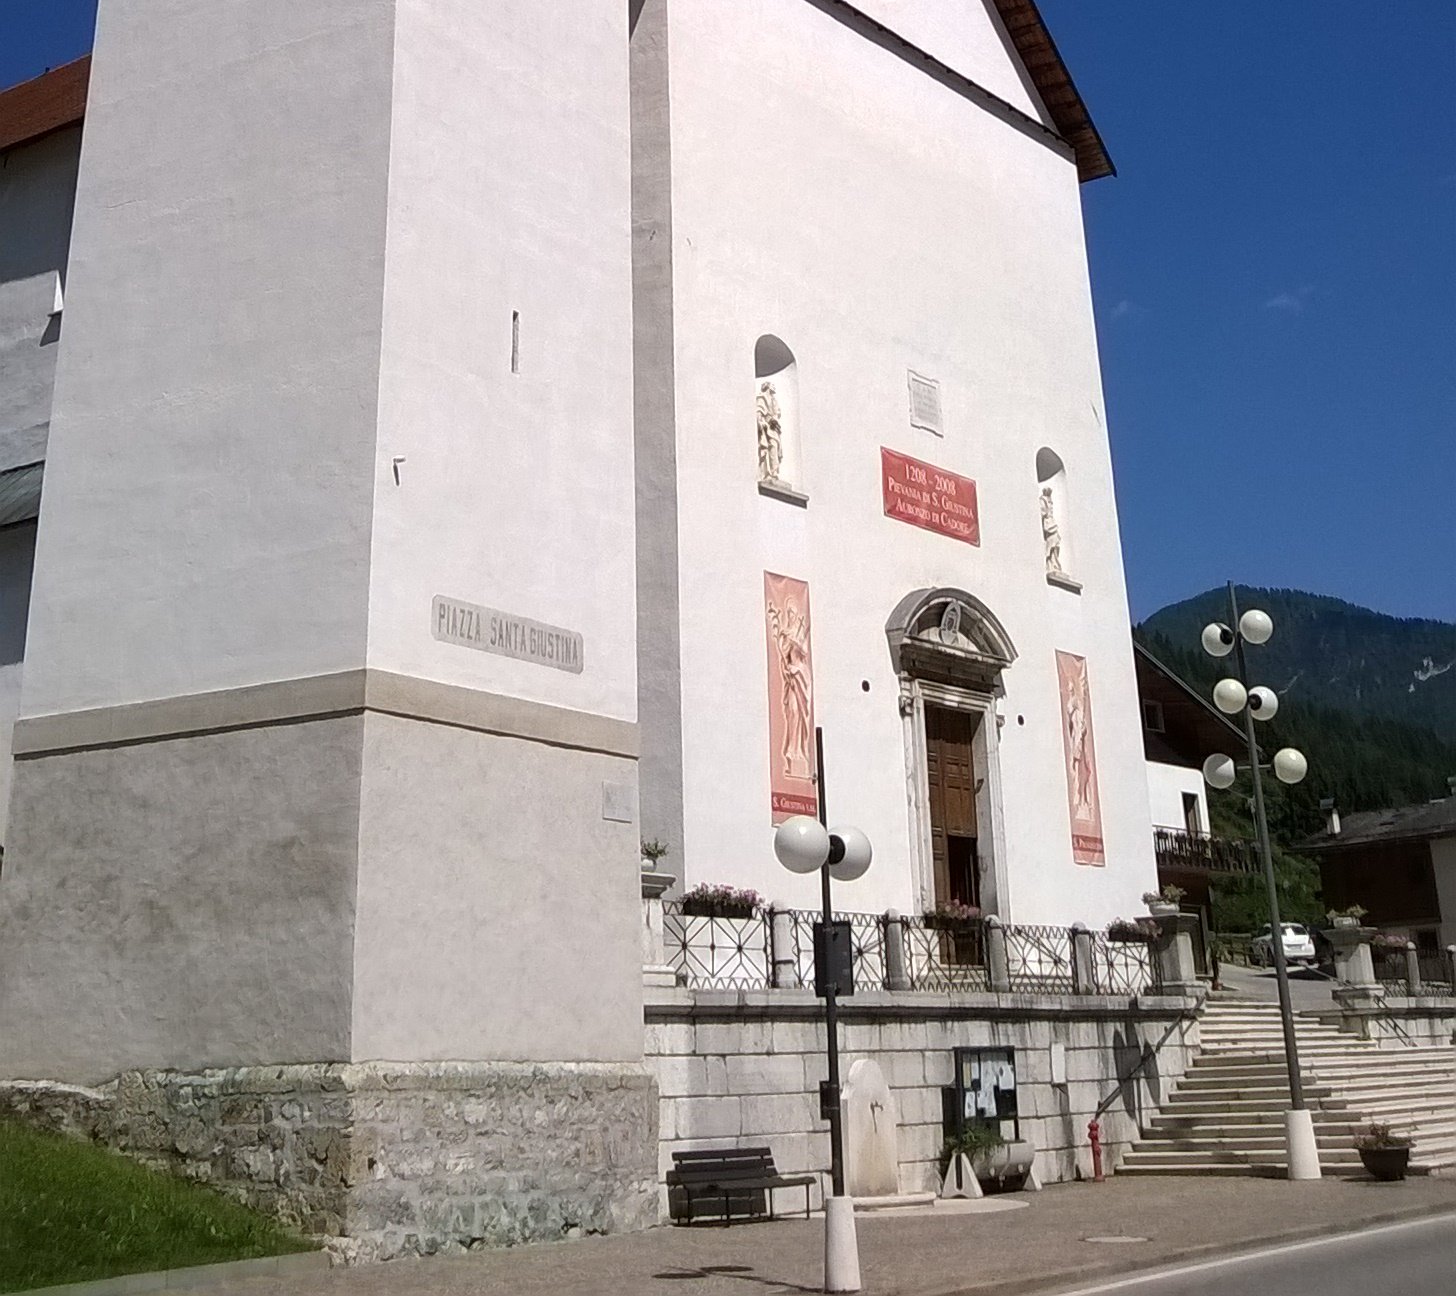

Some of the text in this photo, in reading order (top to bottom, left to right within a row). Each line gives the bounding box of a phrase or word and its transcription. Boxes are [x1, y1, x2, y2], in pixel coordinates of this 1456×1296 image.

[905, 464, 927, 486] 1208
[934, 474, 956, 496] 2008
[931, 492, 940, 508] S.
[438, 603, 579, 665] PIAZZA SANTA GIUSTINA
